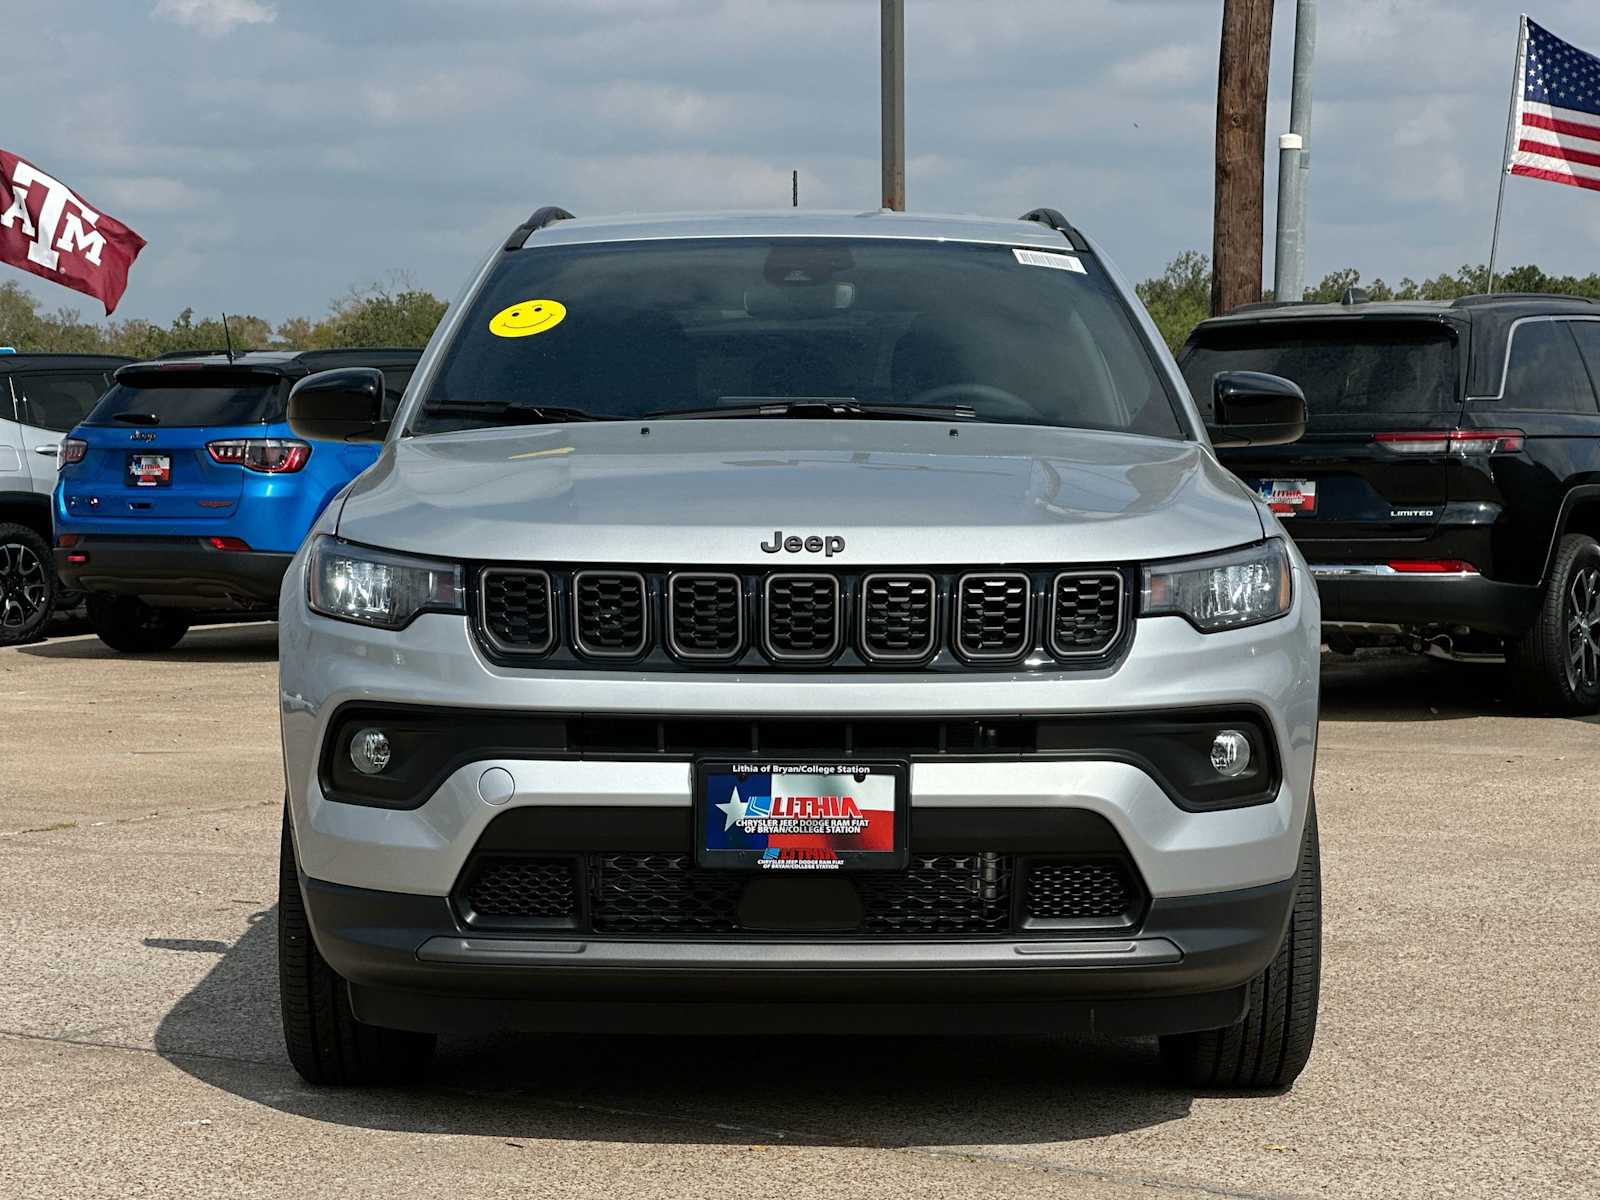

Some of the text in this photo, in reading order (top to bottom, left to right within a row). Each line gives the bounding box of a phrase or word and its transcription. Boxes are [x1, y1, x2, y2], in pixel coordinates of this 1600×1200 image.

[760, 531, 845, 557] Jeep
[732, 764, 870, 775] Lithia of Bryan/College Station
[770, 795, 863, 818] LITHIA
[735, 819, 869, 827] CHRYSLER JEEP DODGE RAM FIAT
[744, 826, 861, 834] OF BRYAN/COLLEGE STATION
